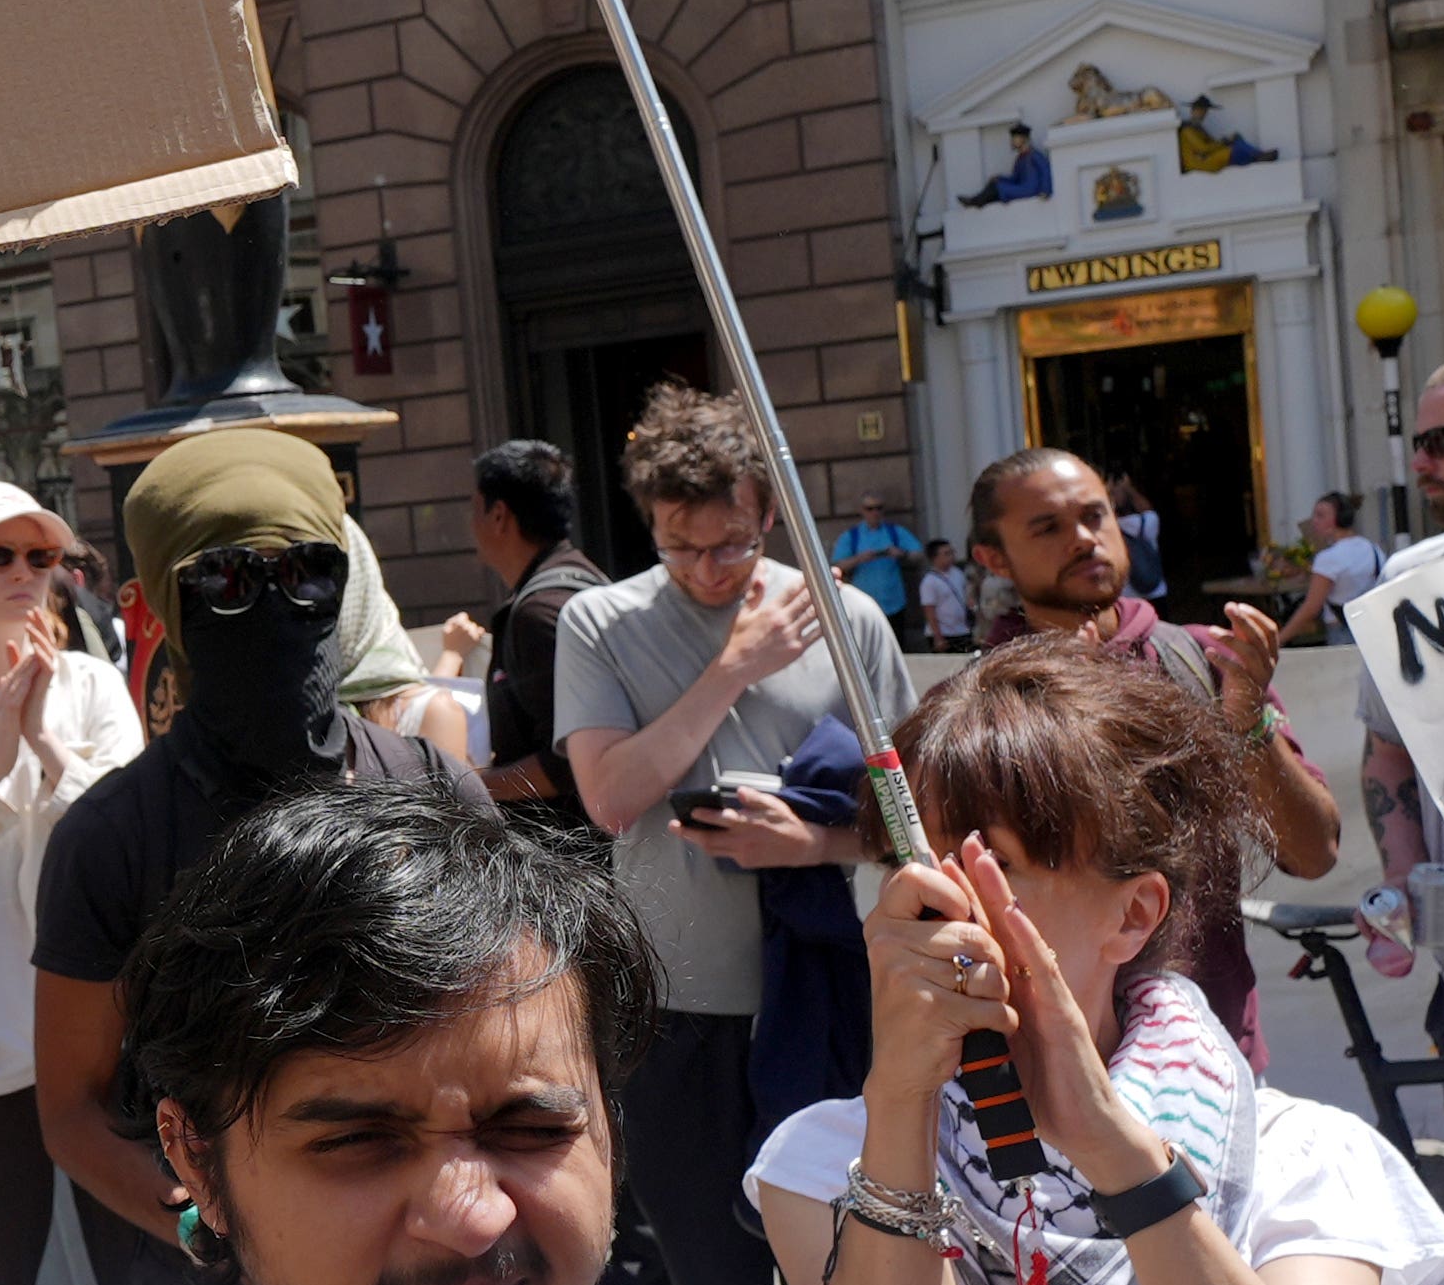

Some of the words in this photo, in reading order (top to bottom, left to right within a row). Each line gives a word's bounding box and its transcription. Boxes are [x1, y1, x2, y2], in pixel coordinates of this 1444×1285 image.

[1030, 245, 1210, 290] TWININGS
[873, 776, 911, 855] APARTHEID
[892, 771, 919, 825] ISRELI
